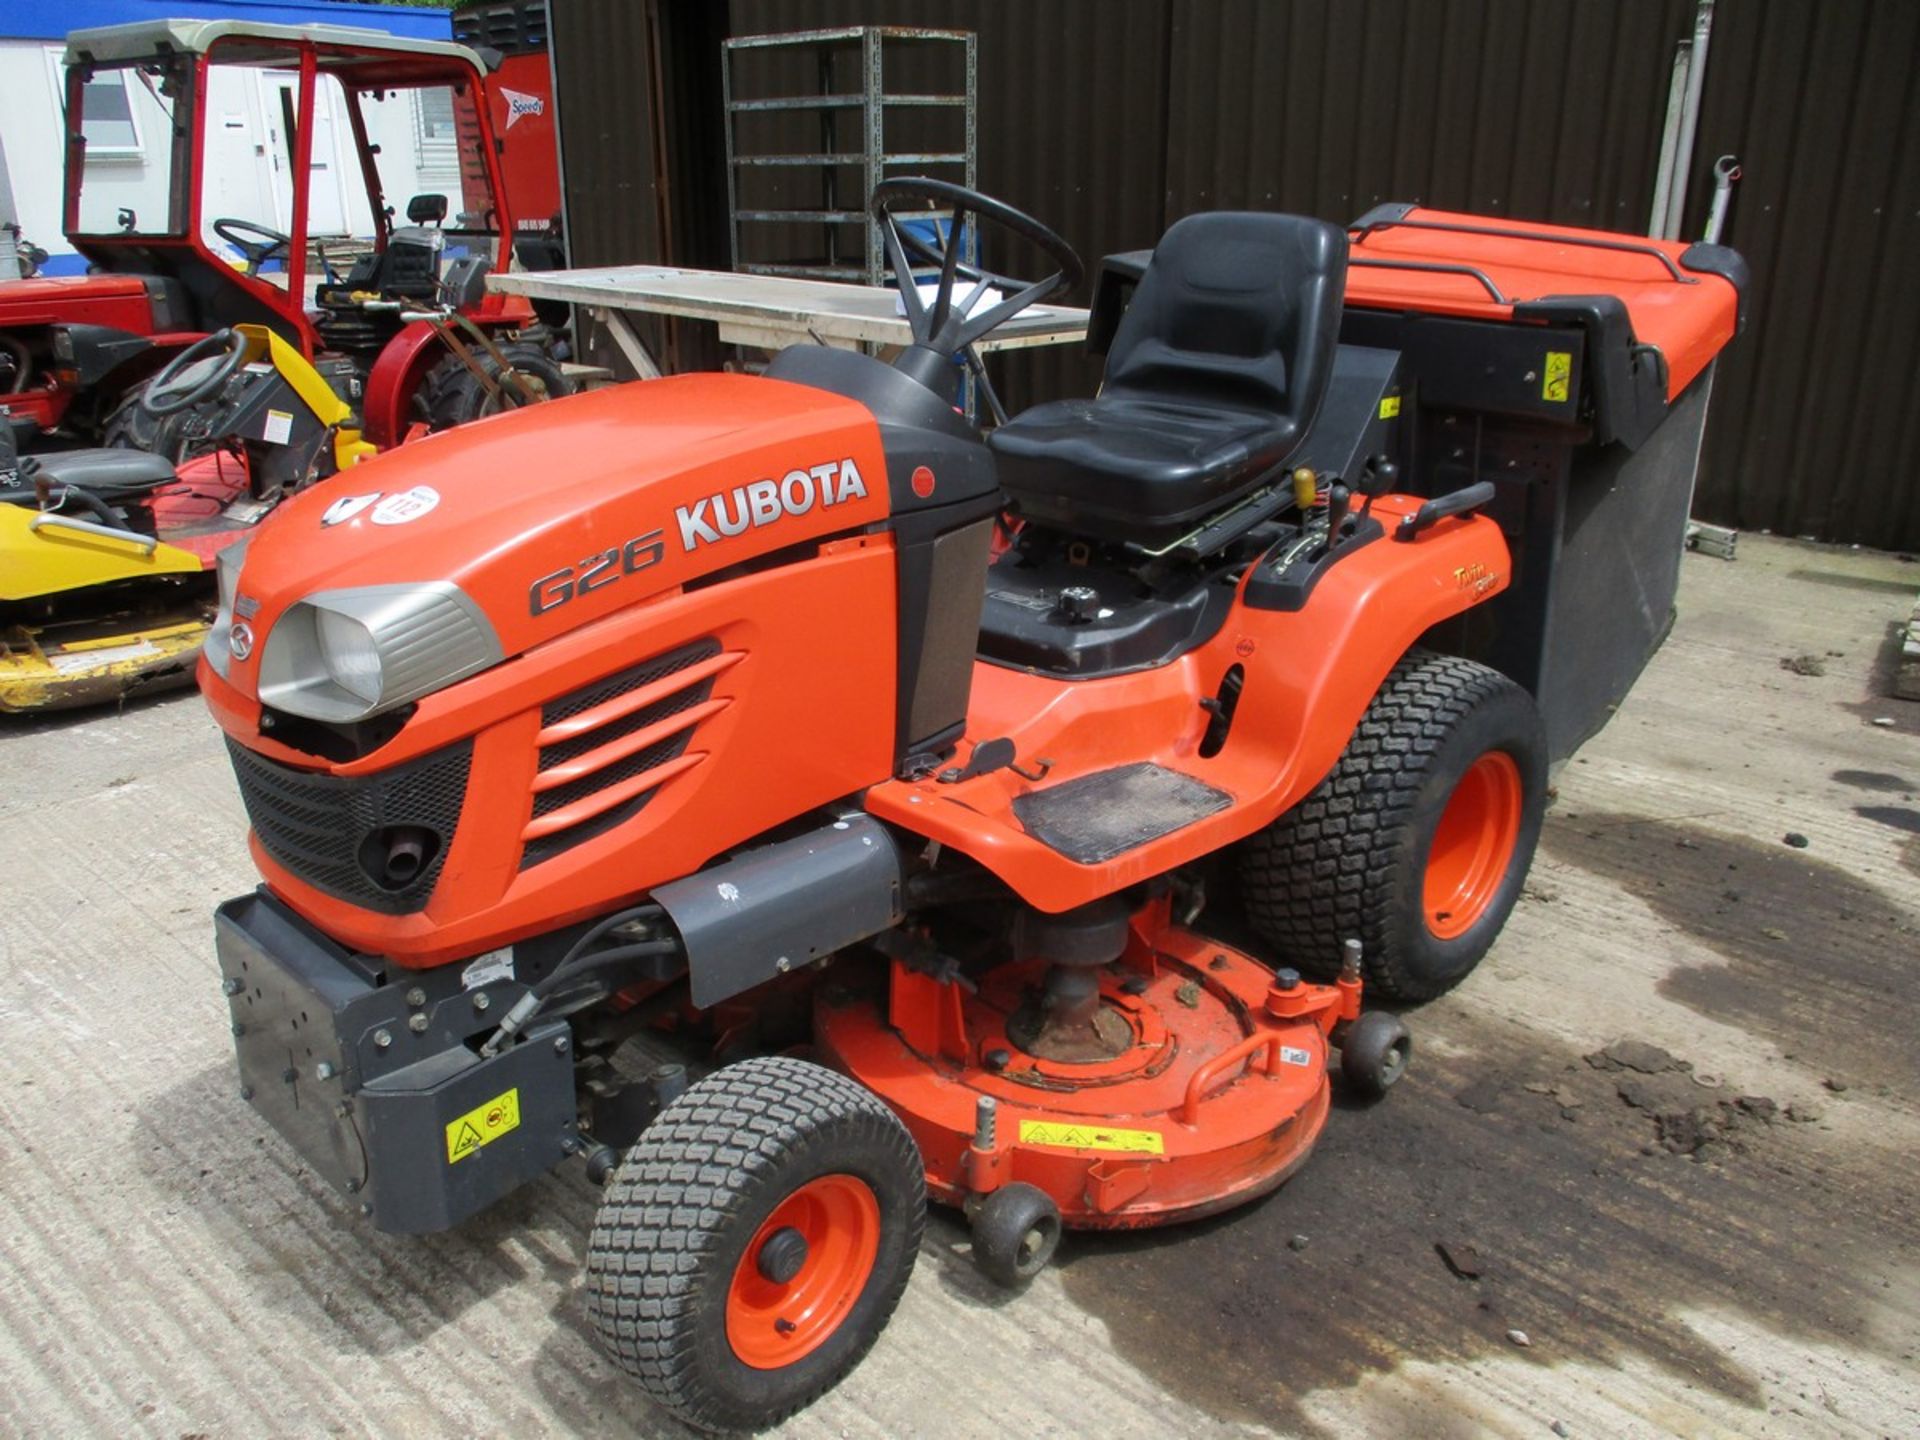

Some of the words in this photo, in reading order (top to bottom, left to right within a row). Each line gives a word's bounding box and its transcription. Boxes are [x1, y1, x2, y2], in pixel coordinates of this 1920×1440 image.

[512, 99, 543, 116] Speedy
[386, 498, 422, 516] 112
[674, 458, 868, 552] KUBOTA
[528, 528, 665, 617] G26
